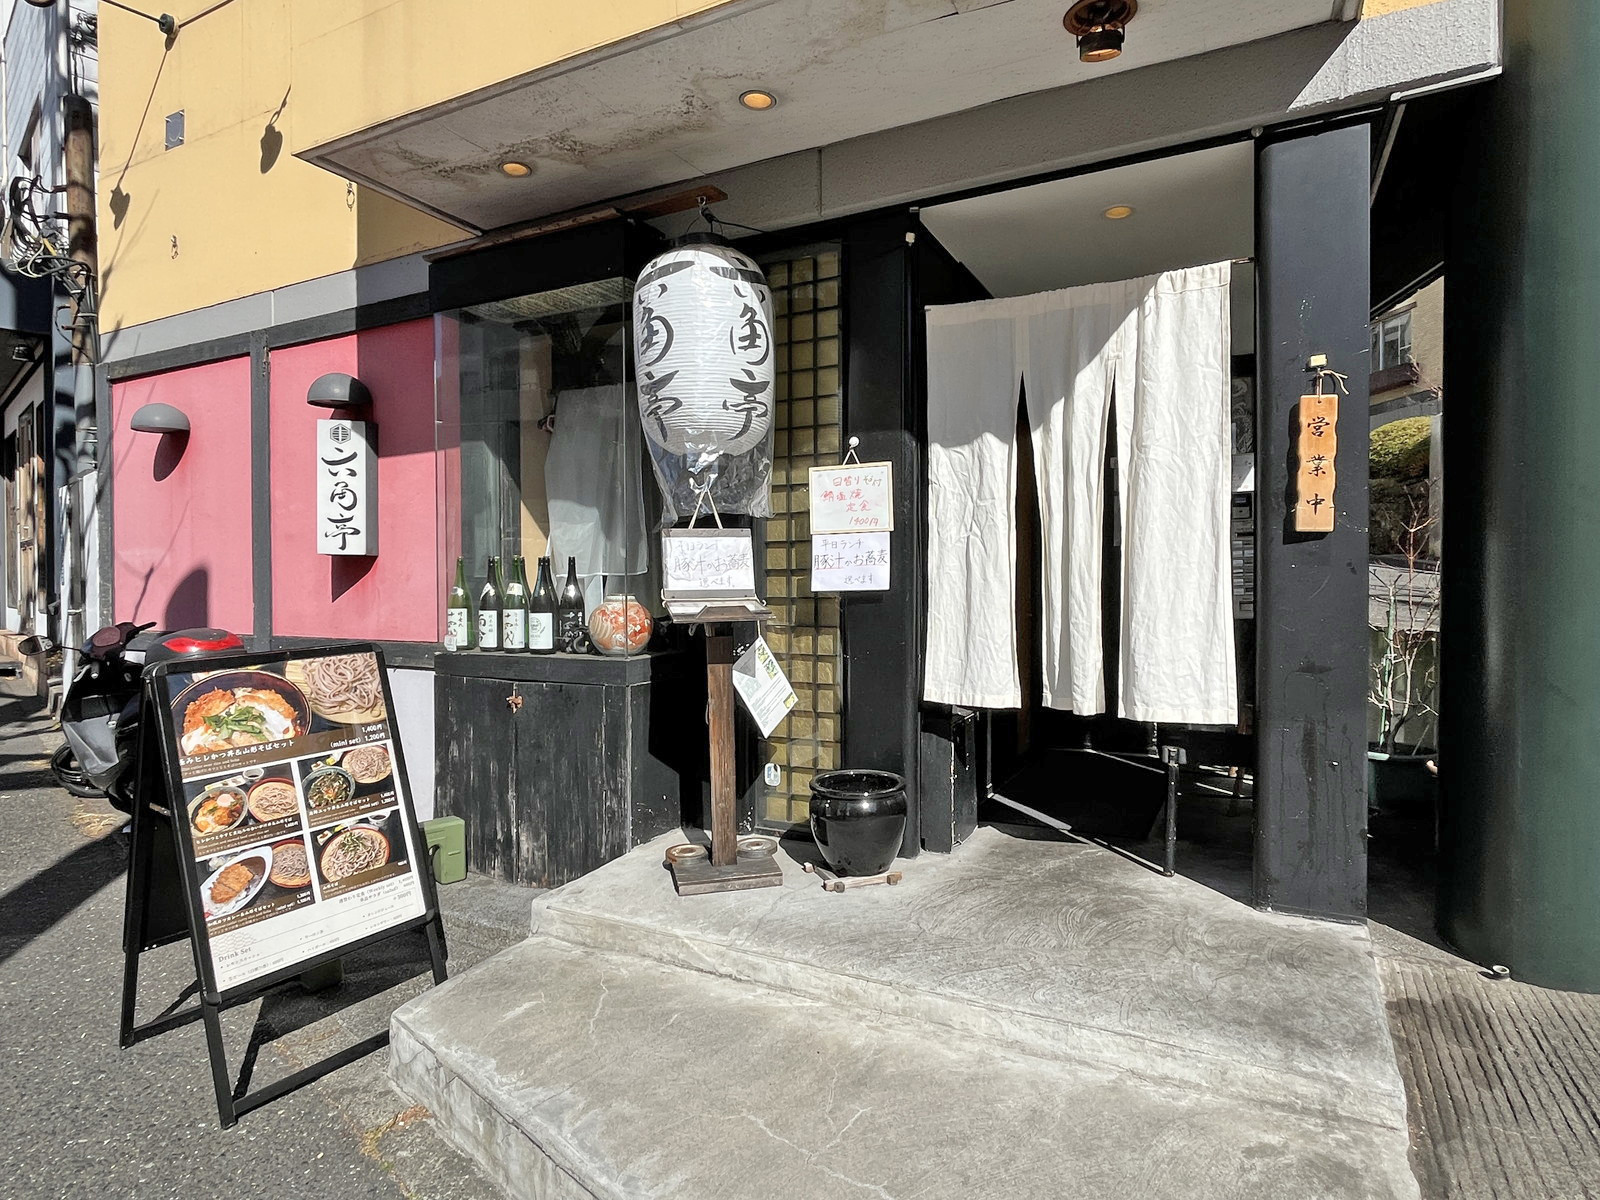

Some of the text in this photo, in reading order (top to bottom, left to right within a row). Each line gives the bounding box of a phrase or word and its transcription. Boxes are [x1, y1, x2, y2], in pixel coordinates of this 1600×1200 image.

[1306, 416, 1330, 515] 営業中
[820, 538, 864, 551] 平日ランチ
[218, 951, 239, 963] Drink
